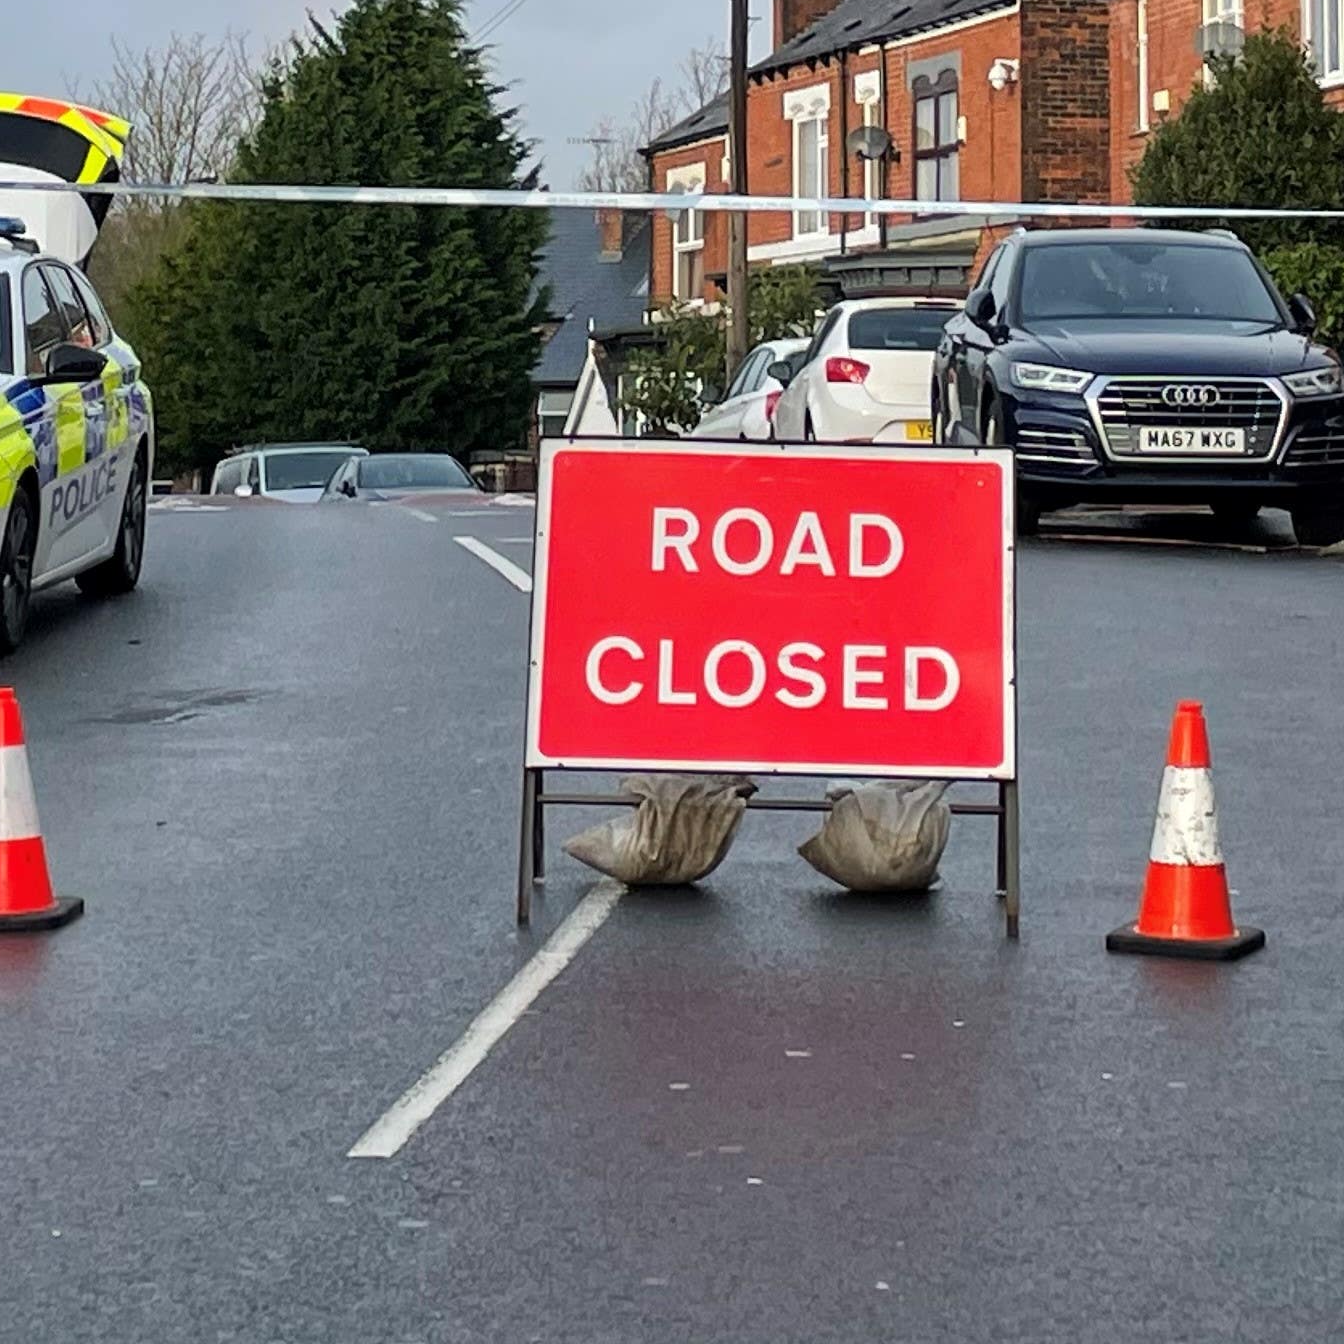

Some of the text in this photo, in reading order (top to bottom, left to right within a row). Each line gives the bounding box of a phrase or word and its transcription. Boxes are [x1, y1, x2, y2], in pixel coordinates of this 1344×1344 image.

[1147, 430, 1236, 448] MA67 WXG
[48, 453, 118, 529] POLICE
[650, 506, 905, 578] ROAD
[584, 635, 961, 712] CLOSED
